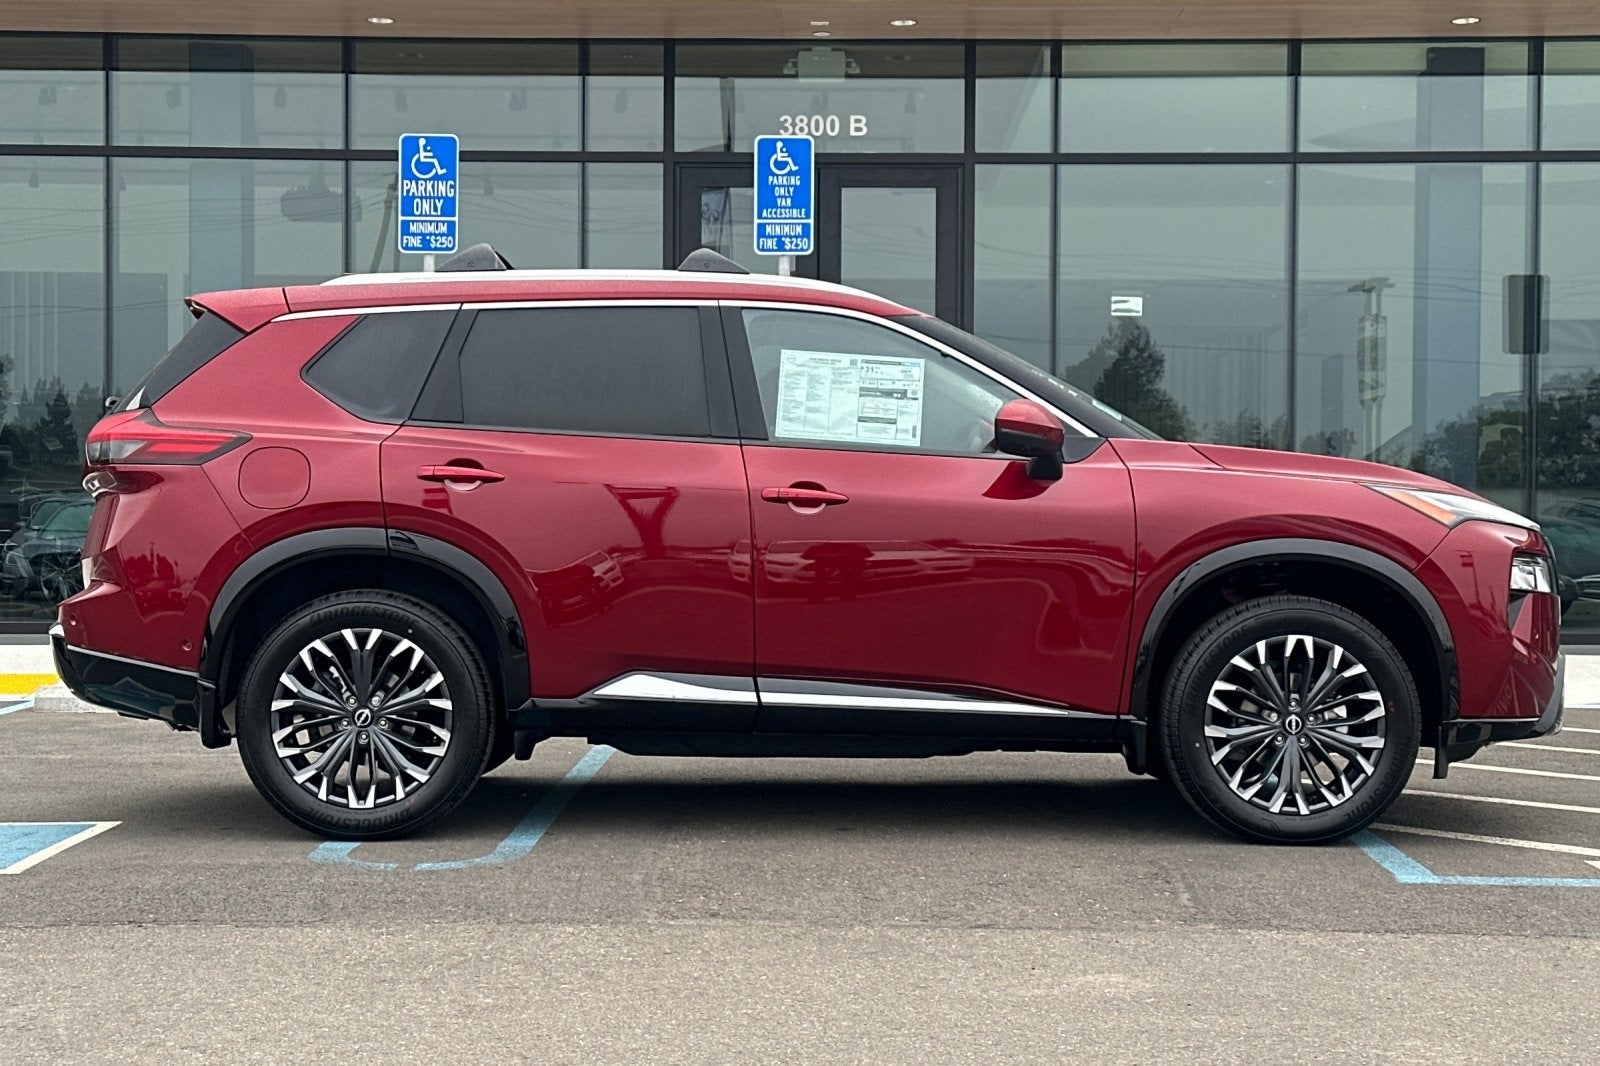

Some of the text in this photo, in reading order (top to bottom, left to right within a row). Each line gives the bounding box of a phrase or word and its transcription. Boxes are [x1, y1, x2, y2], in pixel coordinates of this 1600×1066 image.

[779, 114, 868, 136] 3800 B
[768, 175, 800, 186] PARKING
[403, 180, 455, 197] PARKING
[774, 187, 794, 196] ONLY
[413, 198, 444, 215] ONLY
[776, 197, 792, 207] VAN
[762, 208, 806, 218] ACCESSIBLE
[409, 222, 447, 233] MINIMUM
[765, 224, 802, 236] MINIMUM
[403, 235, 423, 247] FINE
[759, 237, 778, 249] FINE
